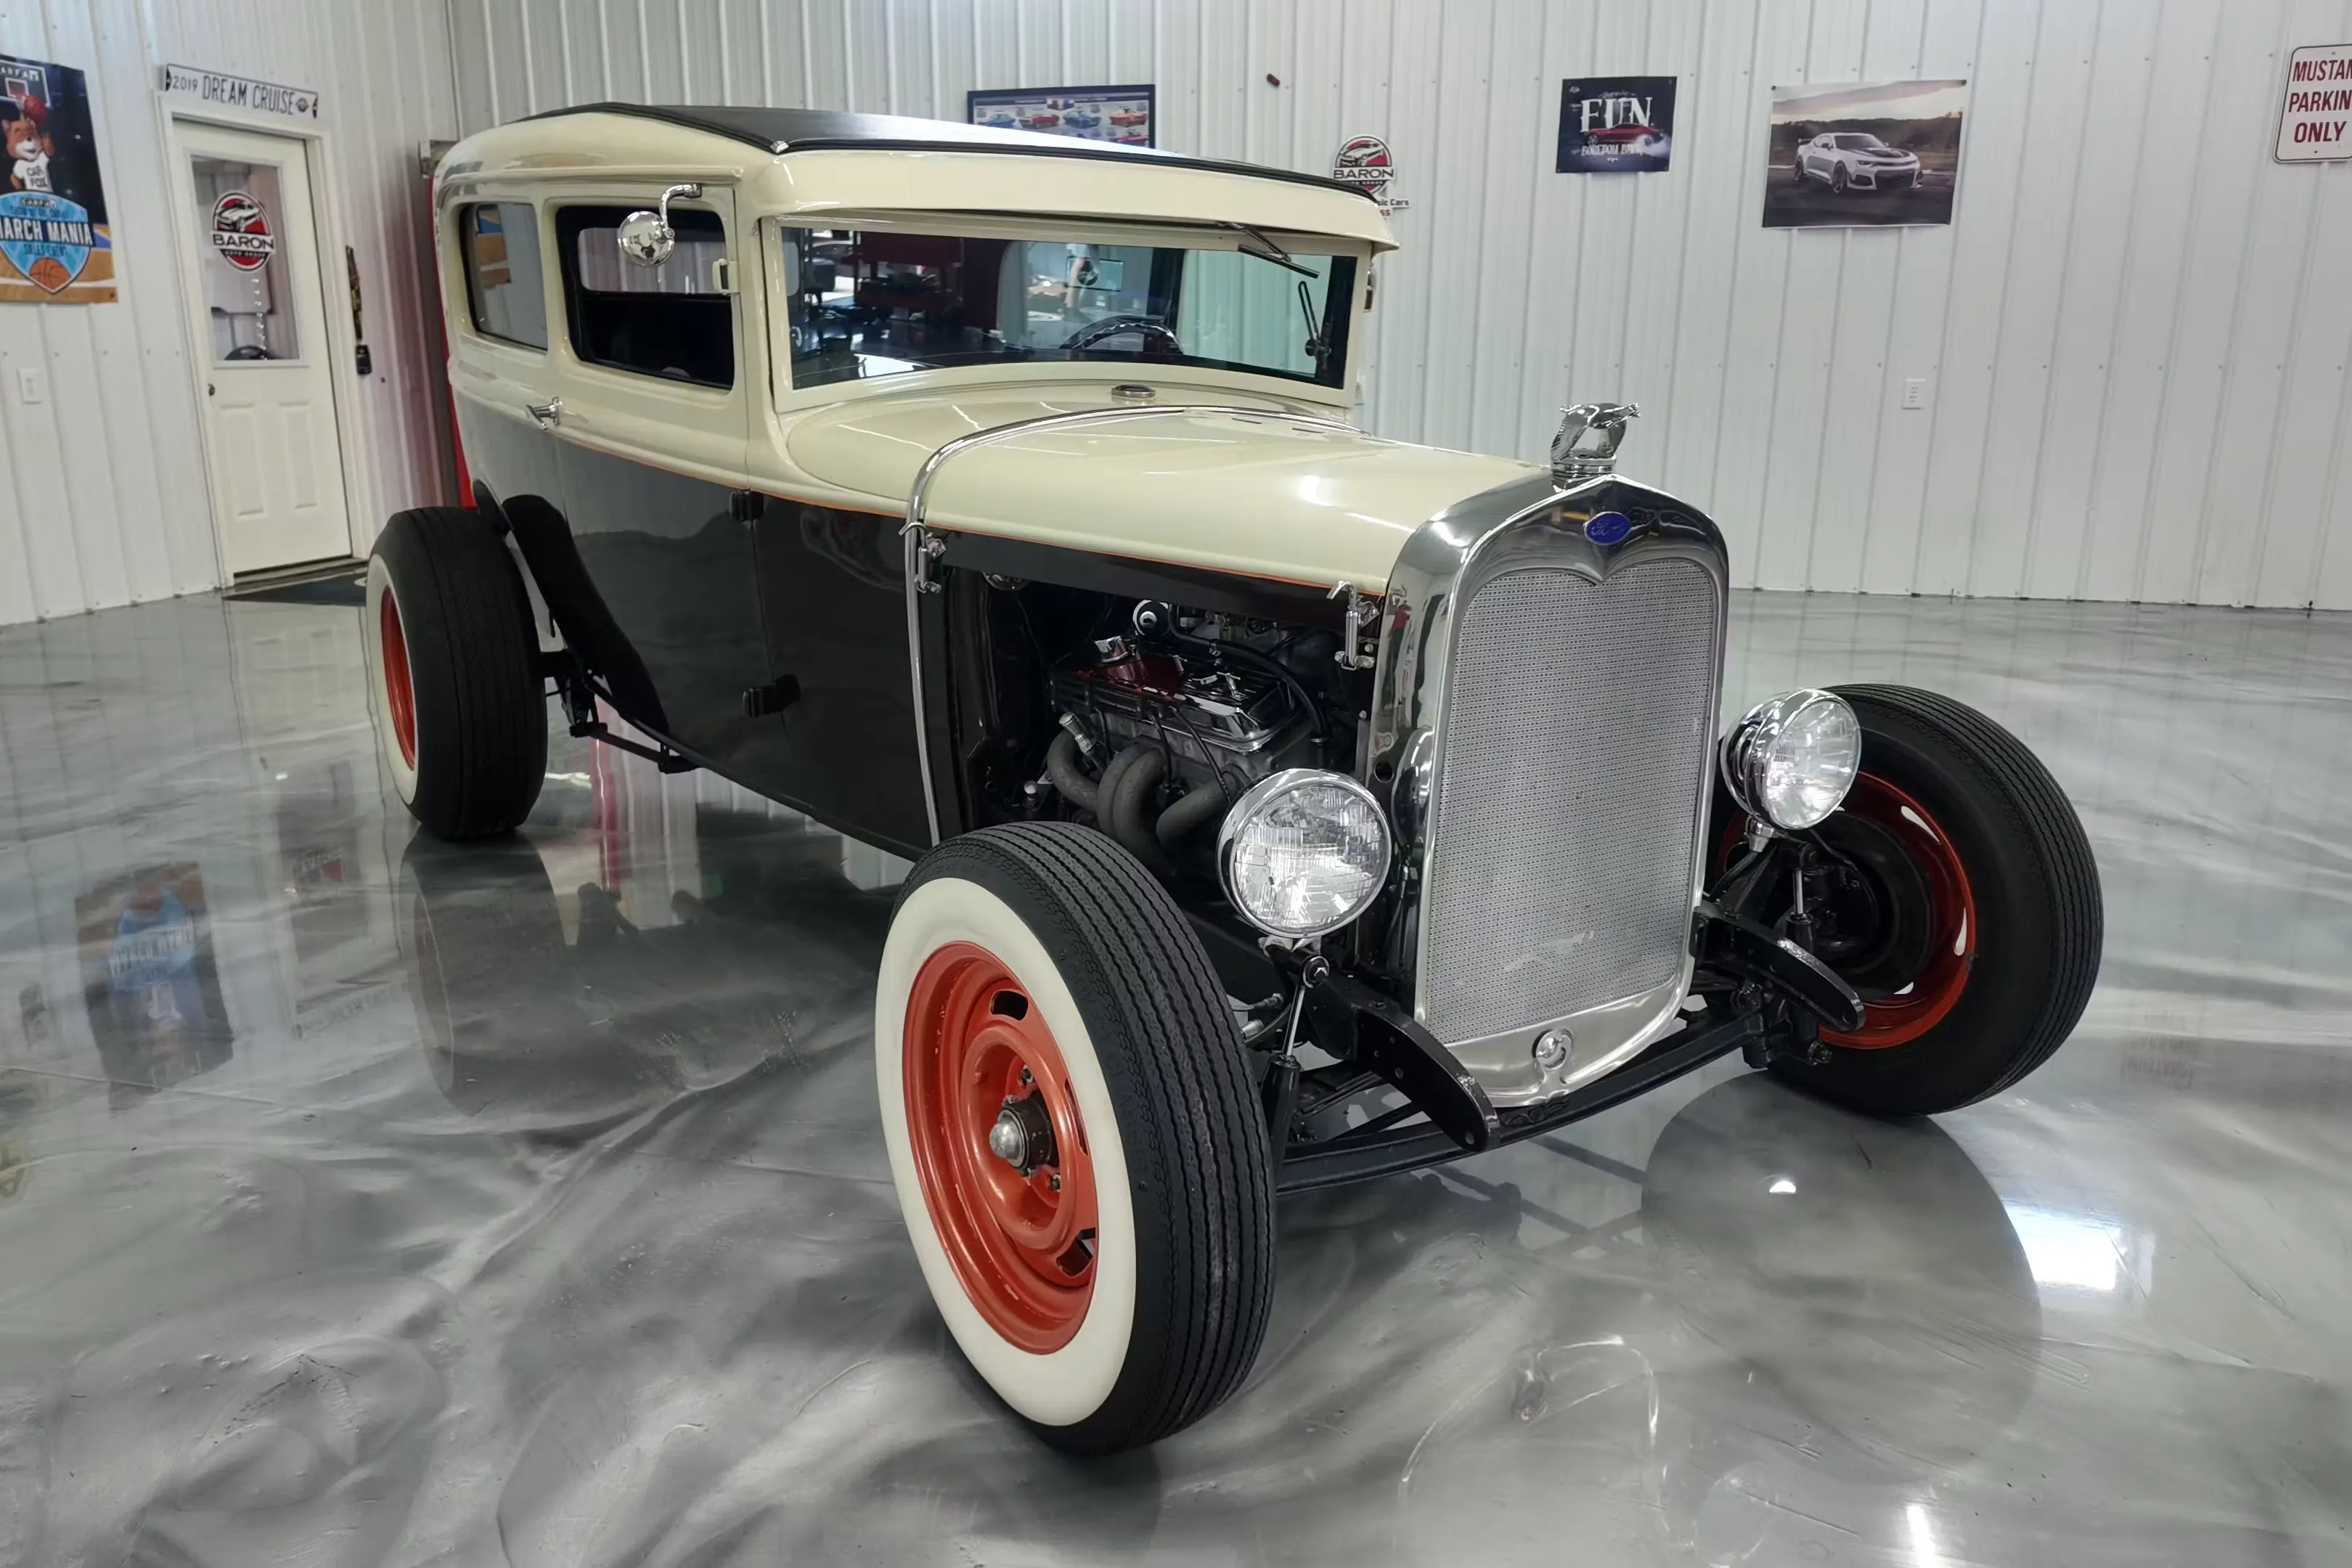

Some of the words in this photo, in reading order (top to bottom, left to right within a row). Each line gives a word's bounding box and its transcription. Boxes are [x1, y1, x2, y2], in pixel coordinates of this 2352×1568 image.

[173, 75, 199, 91] 2019
[202, 75, 248, 107] DREAM
[252, 85, 295, 116] CRUISE
[2288, 89, 2352, 113] PARKIN
[1579, 97, 1654, 133] FUN
[2294, 121, 2347, 143] ONLY
[1333, 168, 1394, 179] BARON
[46, 220, 94, 245] MANIA
[212, 234, 274, 250] BARON
